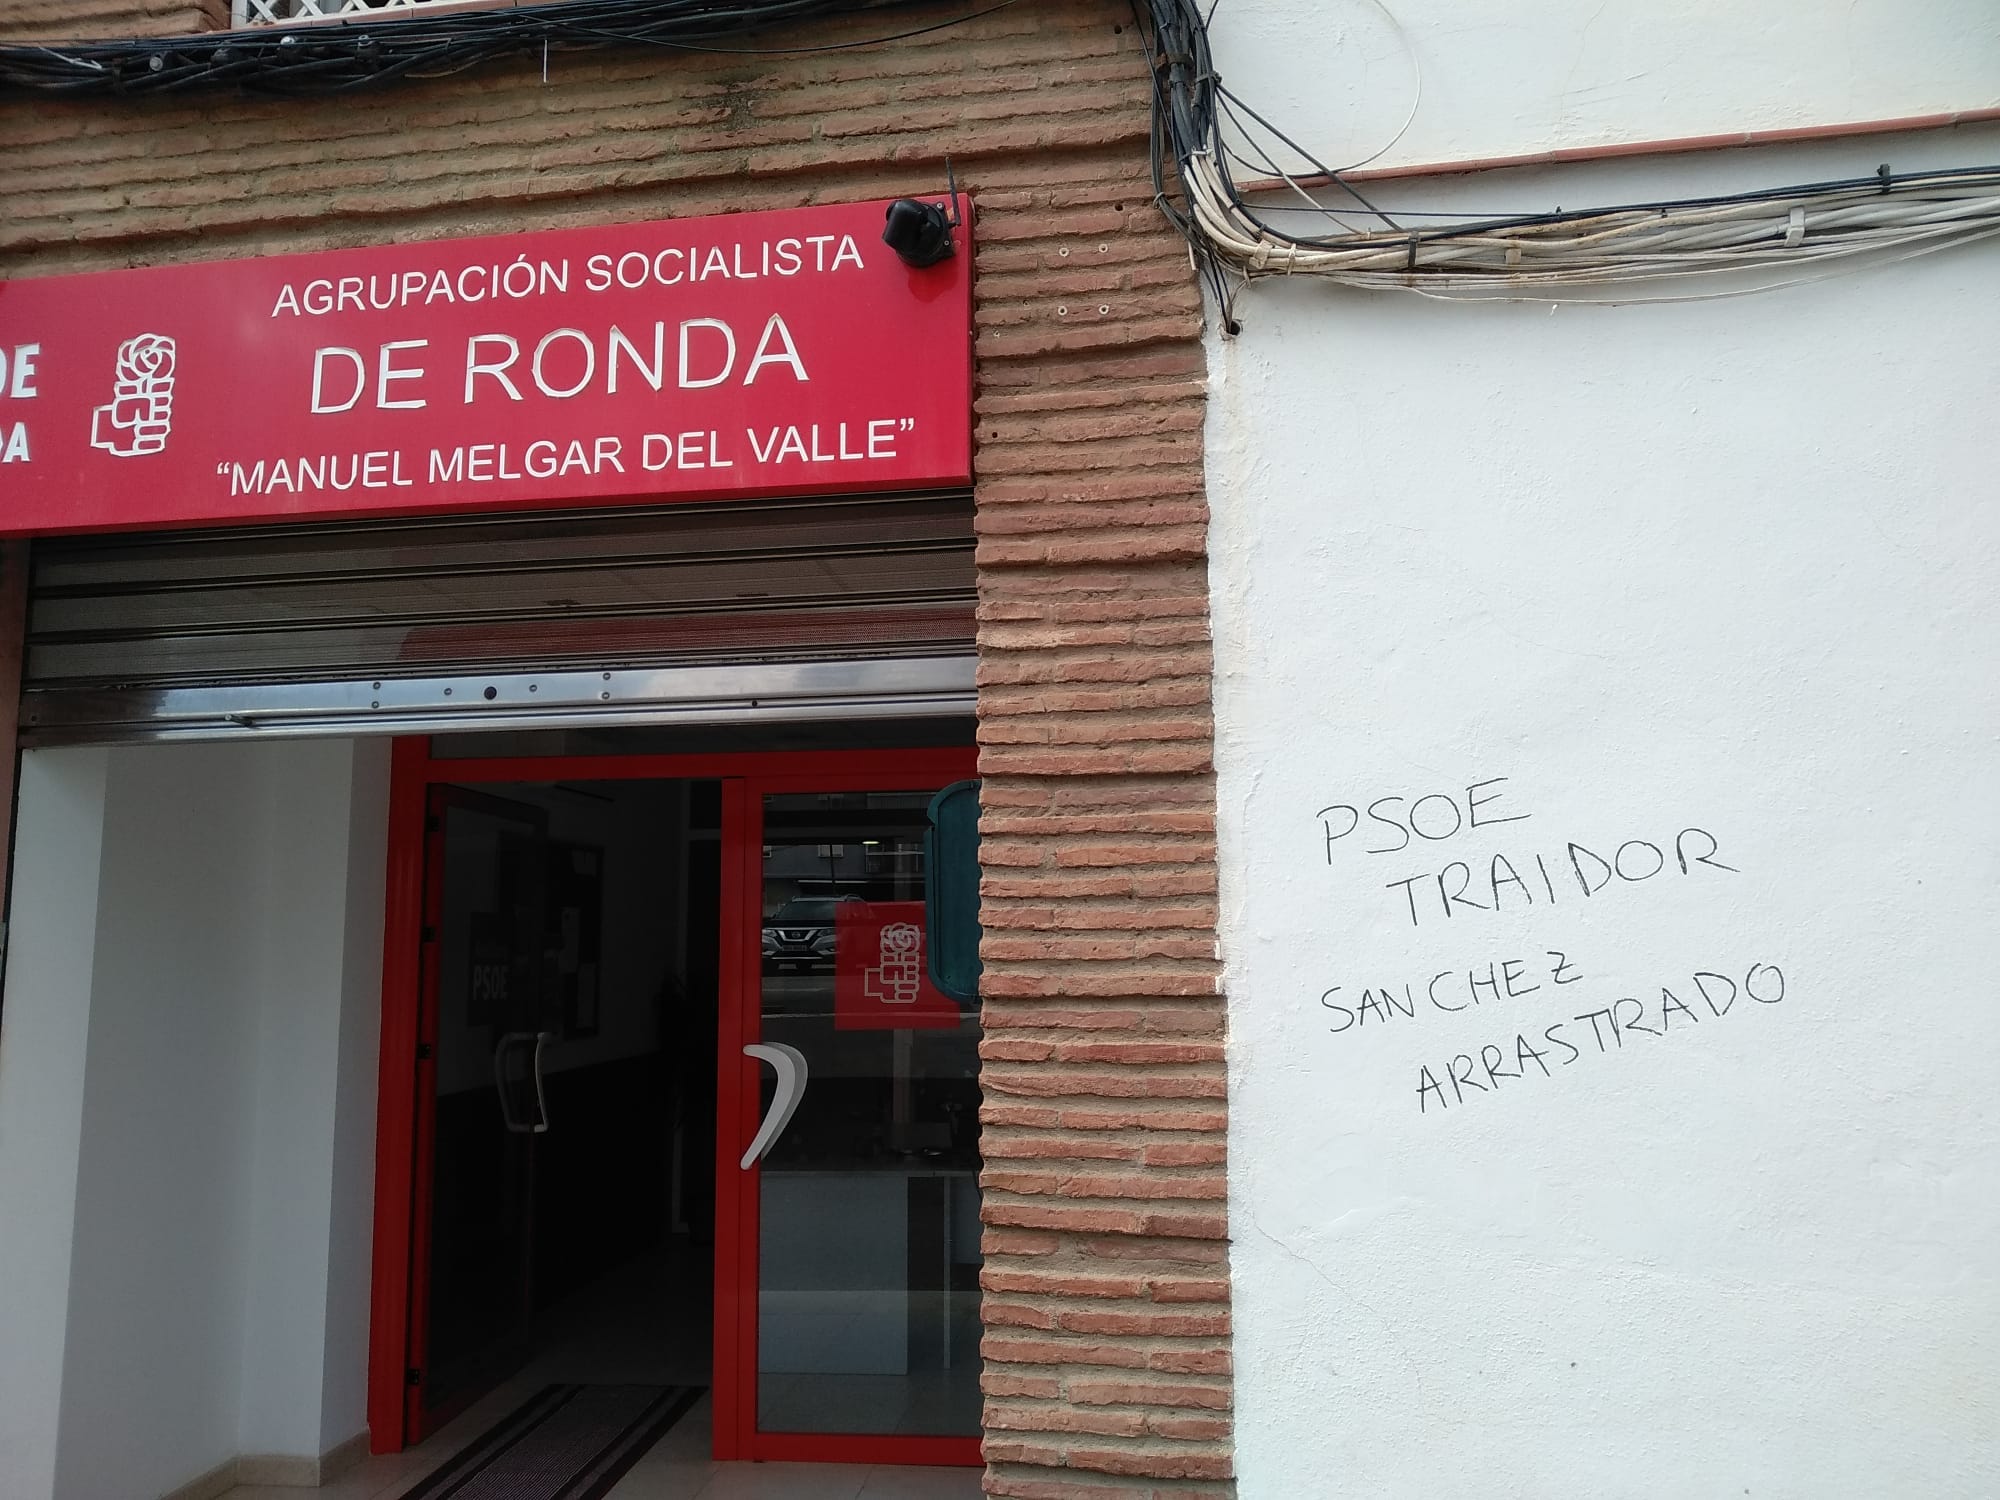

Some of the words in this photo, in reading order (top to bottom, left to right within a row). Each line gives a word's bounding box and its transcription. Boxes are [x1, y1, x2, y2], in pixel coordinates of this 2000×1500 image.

[271, 254, 568, 317] AGRUPACIÓN
[585, 235, 864, 291] SOCIALISTA
[0, 343, 40, 398] E
[311, 339, 429, 414] DE
[464, 313, 810, 403] RONDA
[0, 422, 31, 462] A
[428, 436, 626, 483] MELGAR
[642, 431, 733, 471] DEL
[1316, 777, 1532, 864] PSOE
[1386, 828, 1740, 926] TRAIDOR
[472, 965, 510, 1000] PSOE
[1321, 951, 1583, 1032] SANCHEZ
[1416, 962, 1784, 1113] ARRASTRADO
